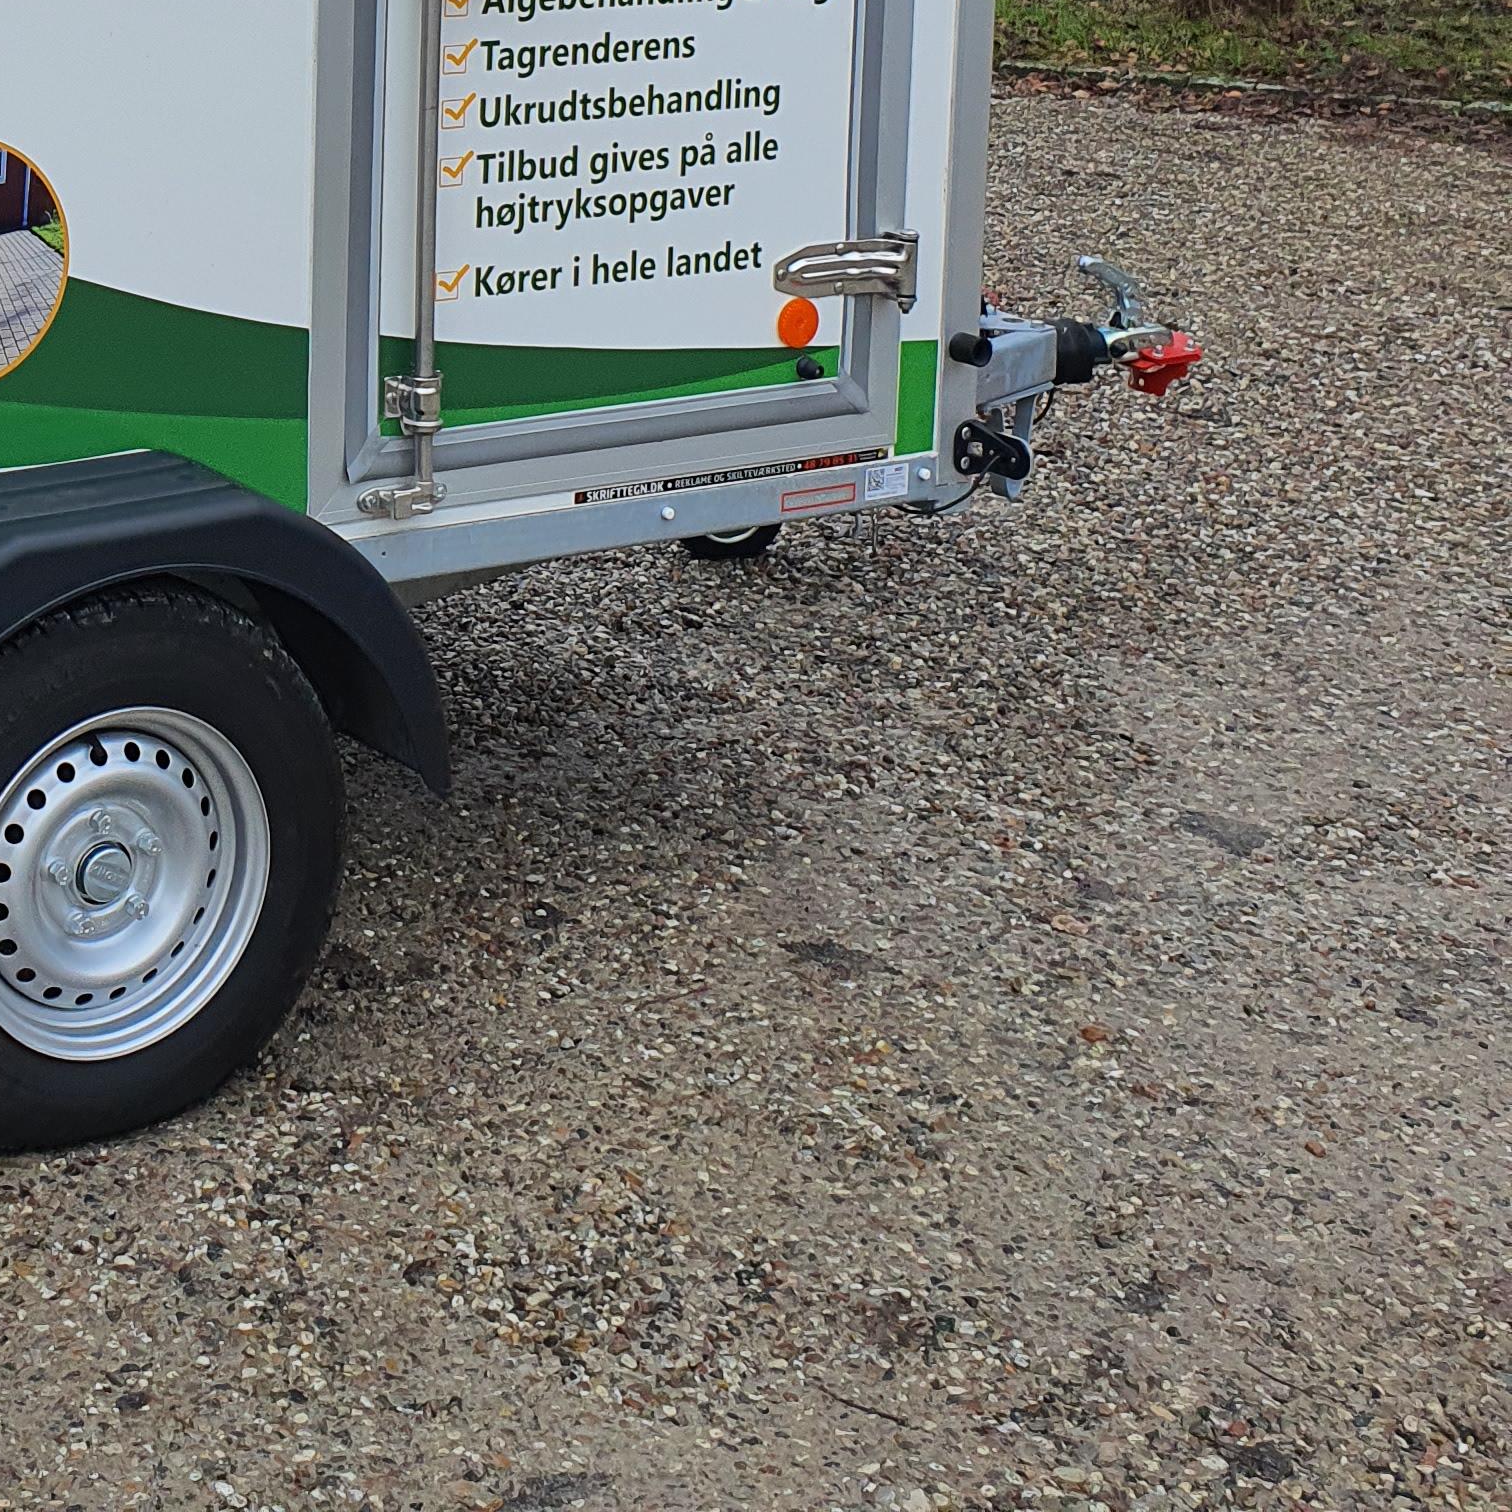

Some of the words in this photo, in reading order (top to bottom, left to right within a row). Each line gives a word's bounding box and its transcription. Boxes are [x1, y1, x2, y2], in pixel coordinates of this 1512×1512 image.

[480, 31, 696, 79] Tagrenderens
[479, 78, 781, 128] Ukrudtsbehandling
[476, 145, 579, 184] Tilbud
[590, 142, 670, 185] gives
[680, 132, 716, 177] på
[726, 130, 779, 164] alle
[475, 180, 736, 234] højtryksopgaver
[475, 265, 563, 297] Kører
[573, 255, 580, 287] i
[592, 249, 656, 285] hele
[667, 240, 762, 277] landet
[586, 481, 664, 503] SKRIFTTEGN.DK
[675, 474, 712, 489] REKLAME
[713, 472, 725, 483] OG
[727, 463, 796, 481] SKILTEVÆRKSTED
